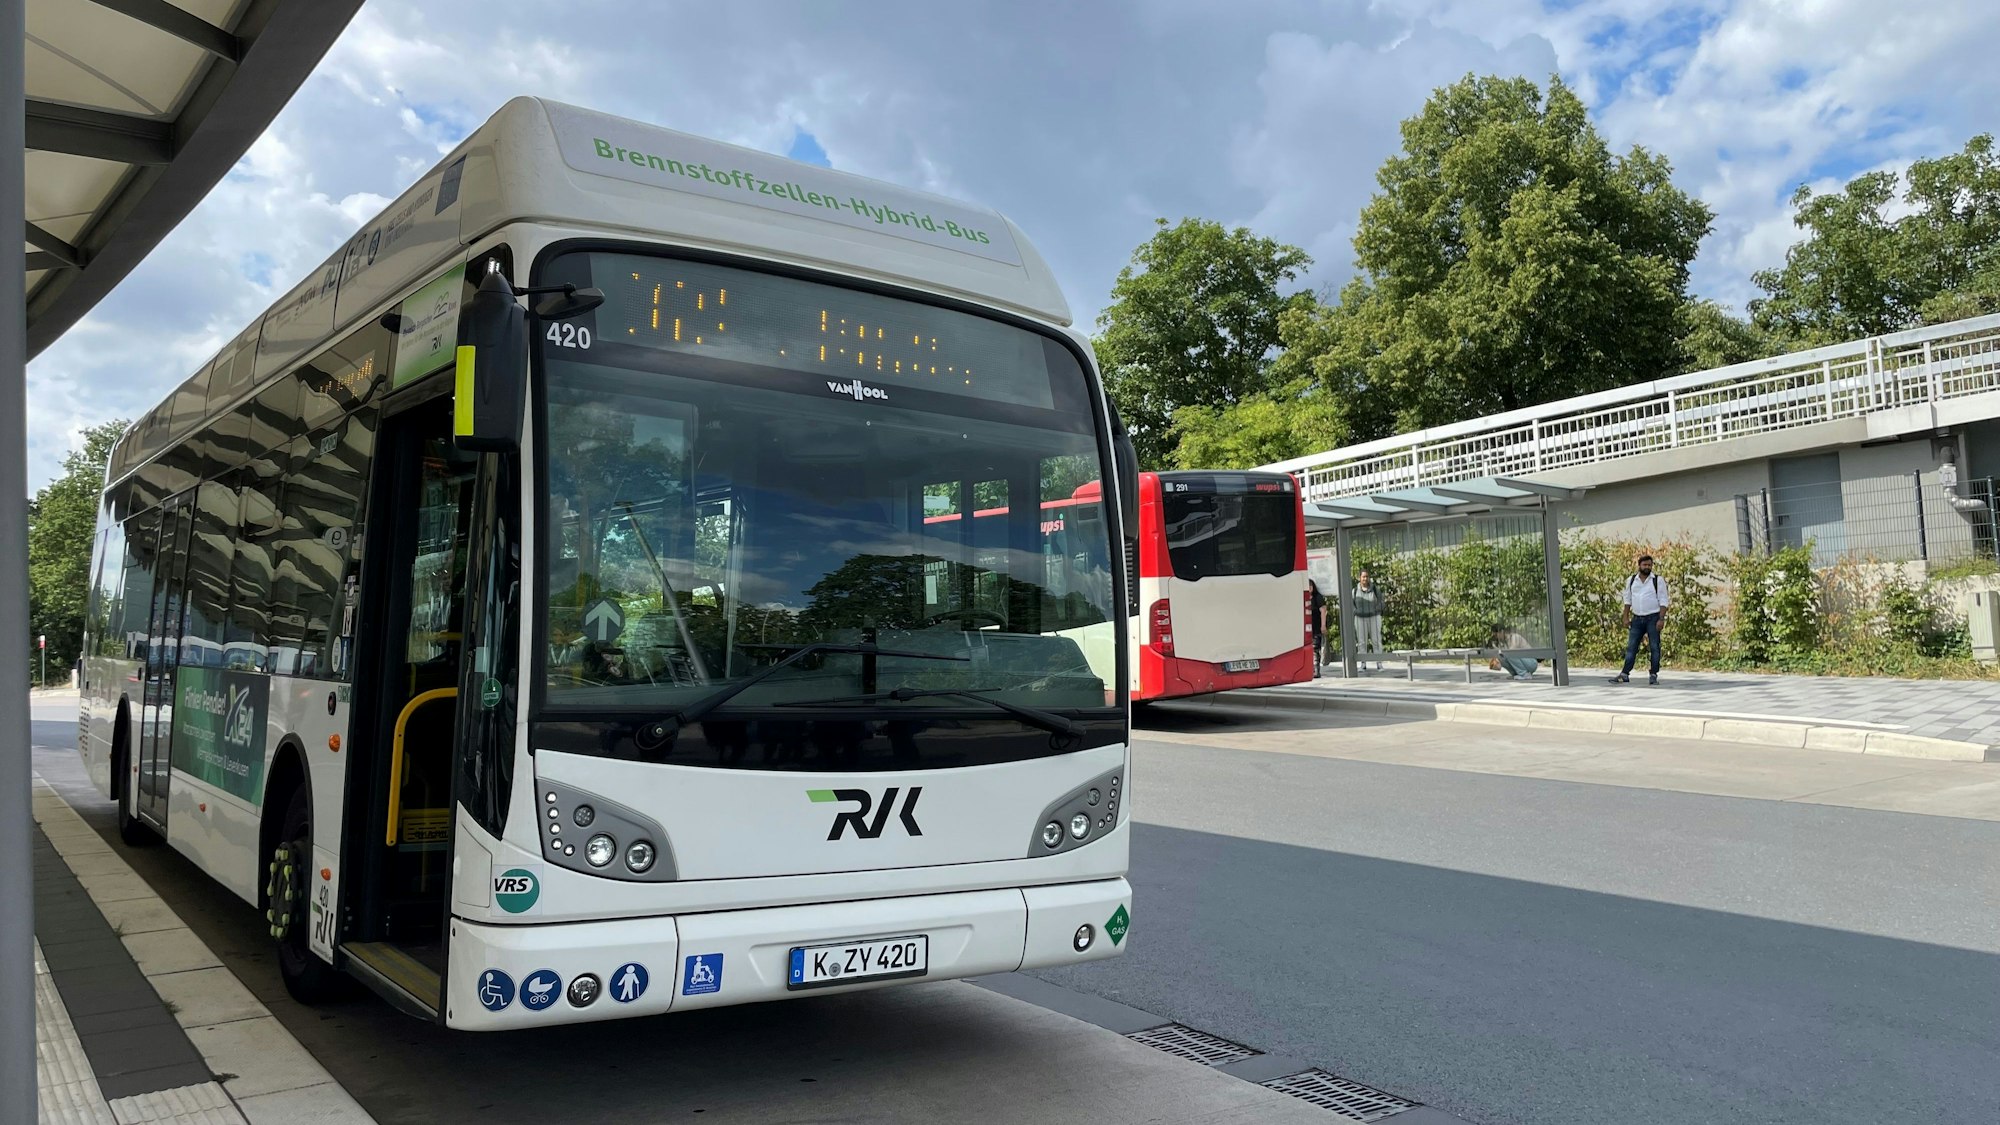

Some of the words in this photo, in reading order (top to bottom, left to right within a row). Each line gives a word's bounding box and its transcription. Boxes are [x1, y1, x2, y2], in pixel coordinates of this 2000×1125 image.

[594, 138, 990, 245] Brennstoffzellen-Hybrid-Bus
[546, 322, 591, 349] 420
[1175, 483, 1188, 492] 291
[1255, 481, 1280, 493] wupsi
[1040, 513, 1064, 535] upsi
[806, 786, 923, 841] RVK
[494, 878, 529, 892] VRS
[1111, 926, 1126, 936] GAS
[814, 951, 829, 977] K
[844, 947, 873, 973] ZY
[877, 942, 917, 969] 420
